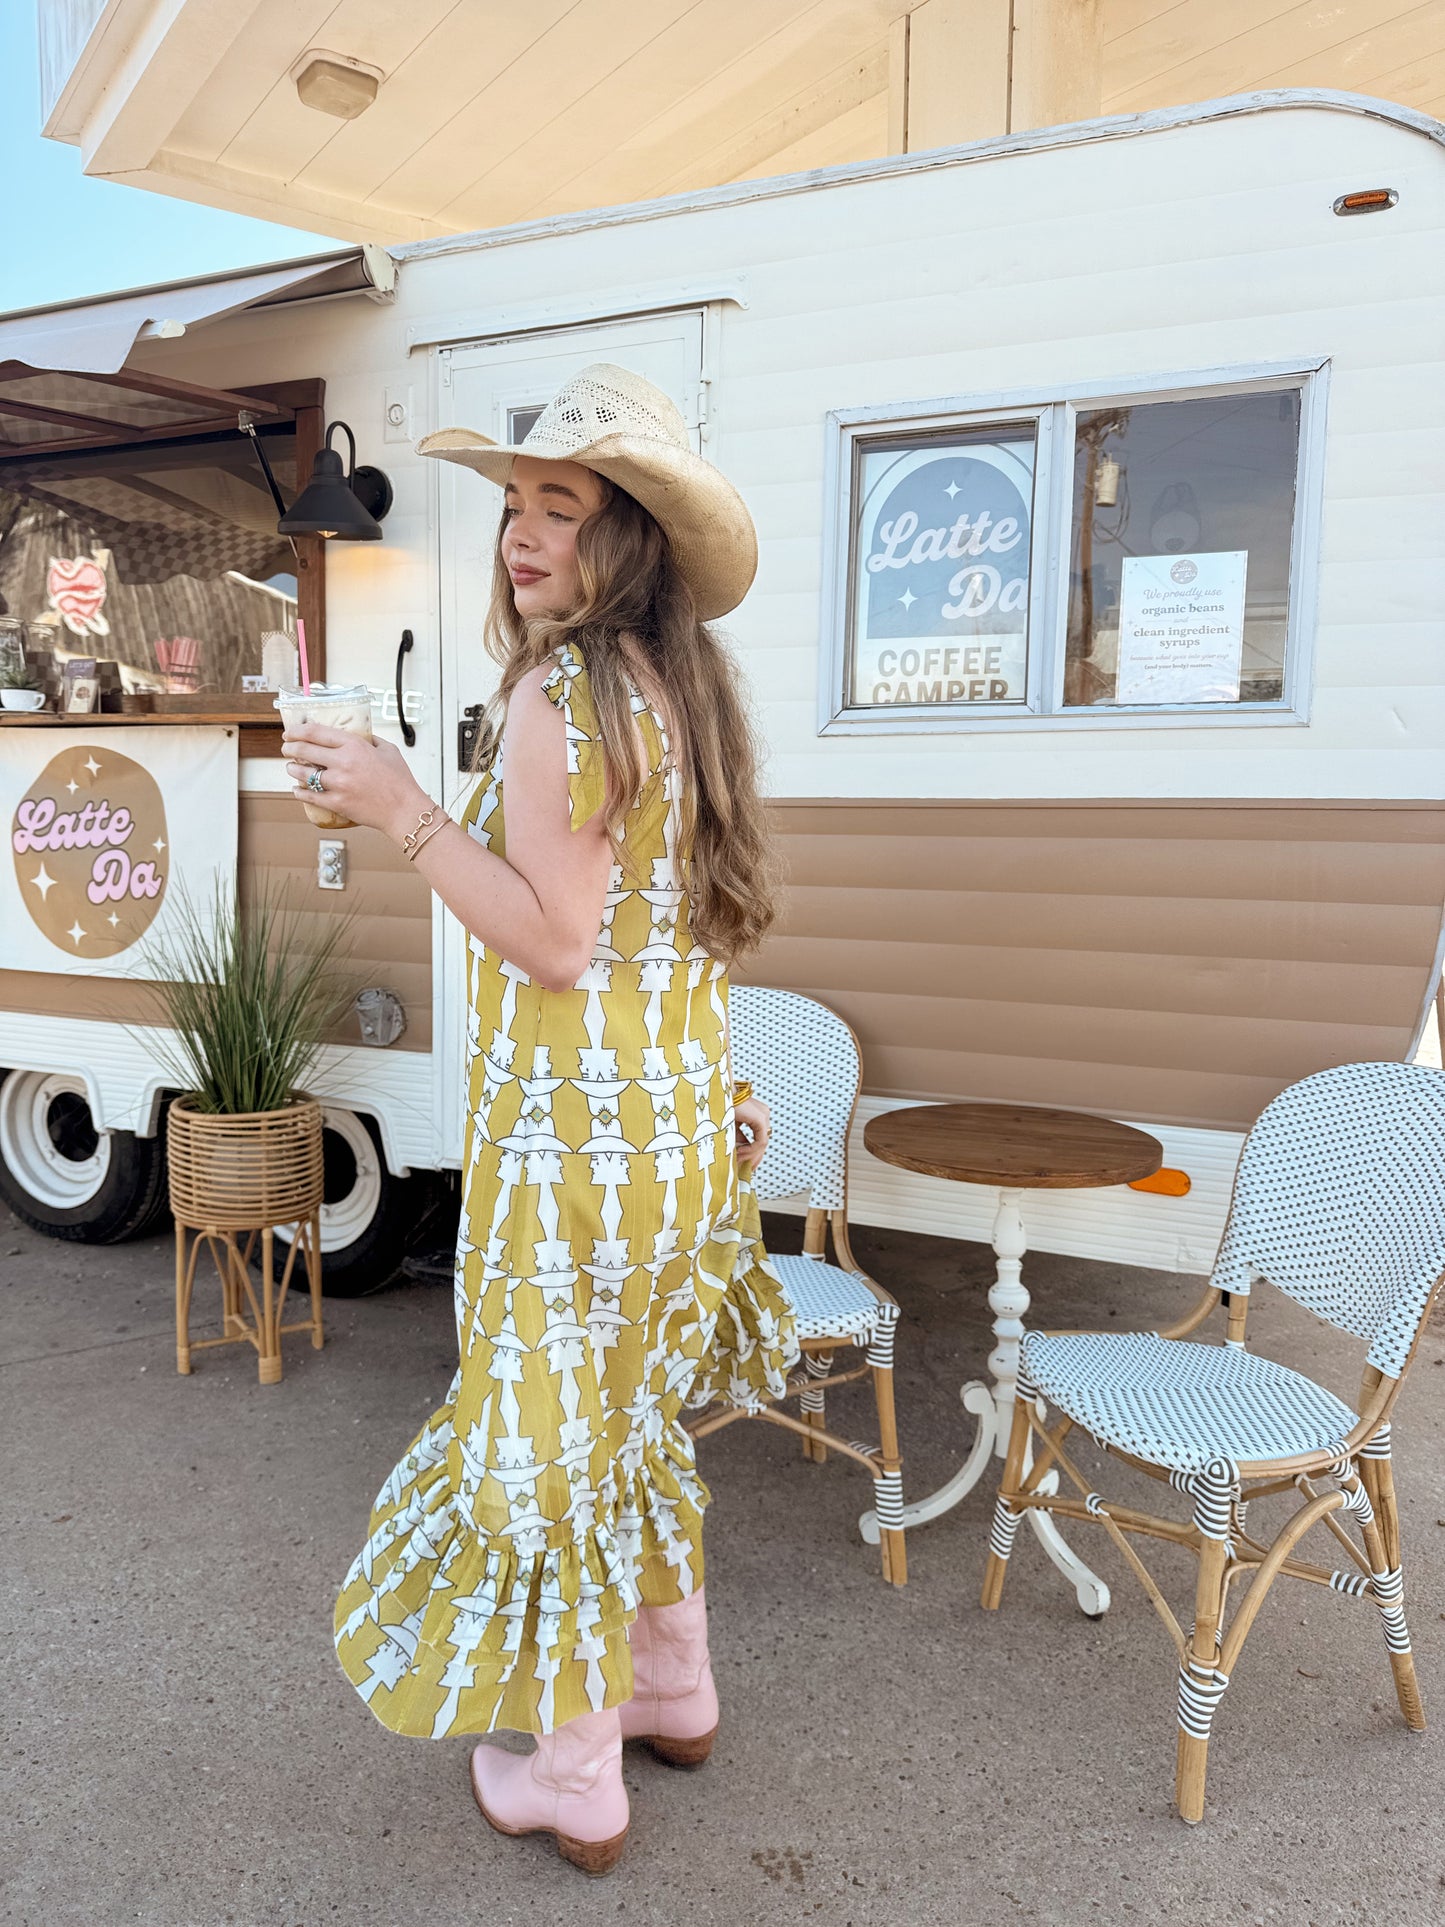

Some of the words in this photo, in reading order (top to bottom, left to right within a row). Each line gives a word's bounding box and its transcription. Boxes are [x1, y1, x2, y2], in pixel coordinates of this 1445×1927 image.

[868, 511, 1022, 573] Latte
[1143, 588, 1162, 600] We
[1162, 587, 1203, 601] proudly
[1204, 588, 1223, 597] use
[1141, 604, 1187, 617] organic
[1188, 603, 1225, 613] beans
[1133, 627, 1165, 637] clean
[1168, 625, 1231, 638] ingredient
[1159, 638, 1201, 649] syrups
[878, 646, 1002, 677] COFFEE
[872, 679, 1009, 704] CAMPER
[12, 797, 135, 854] Latte
[87, 847, 163, 905] Da
